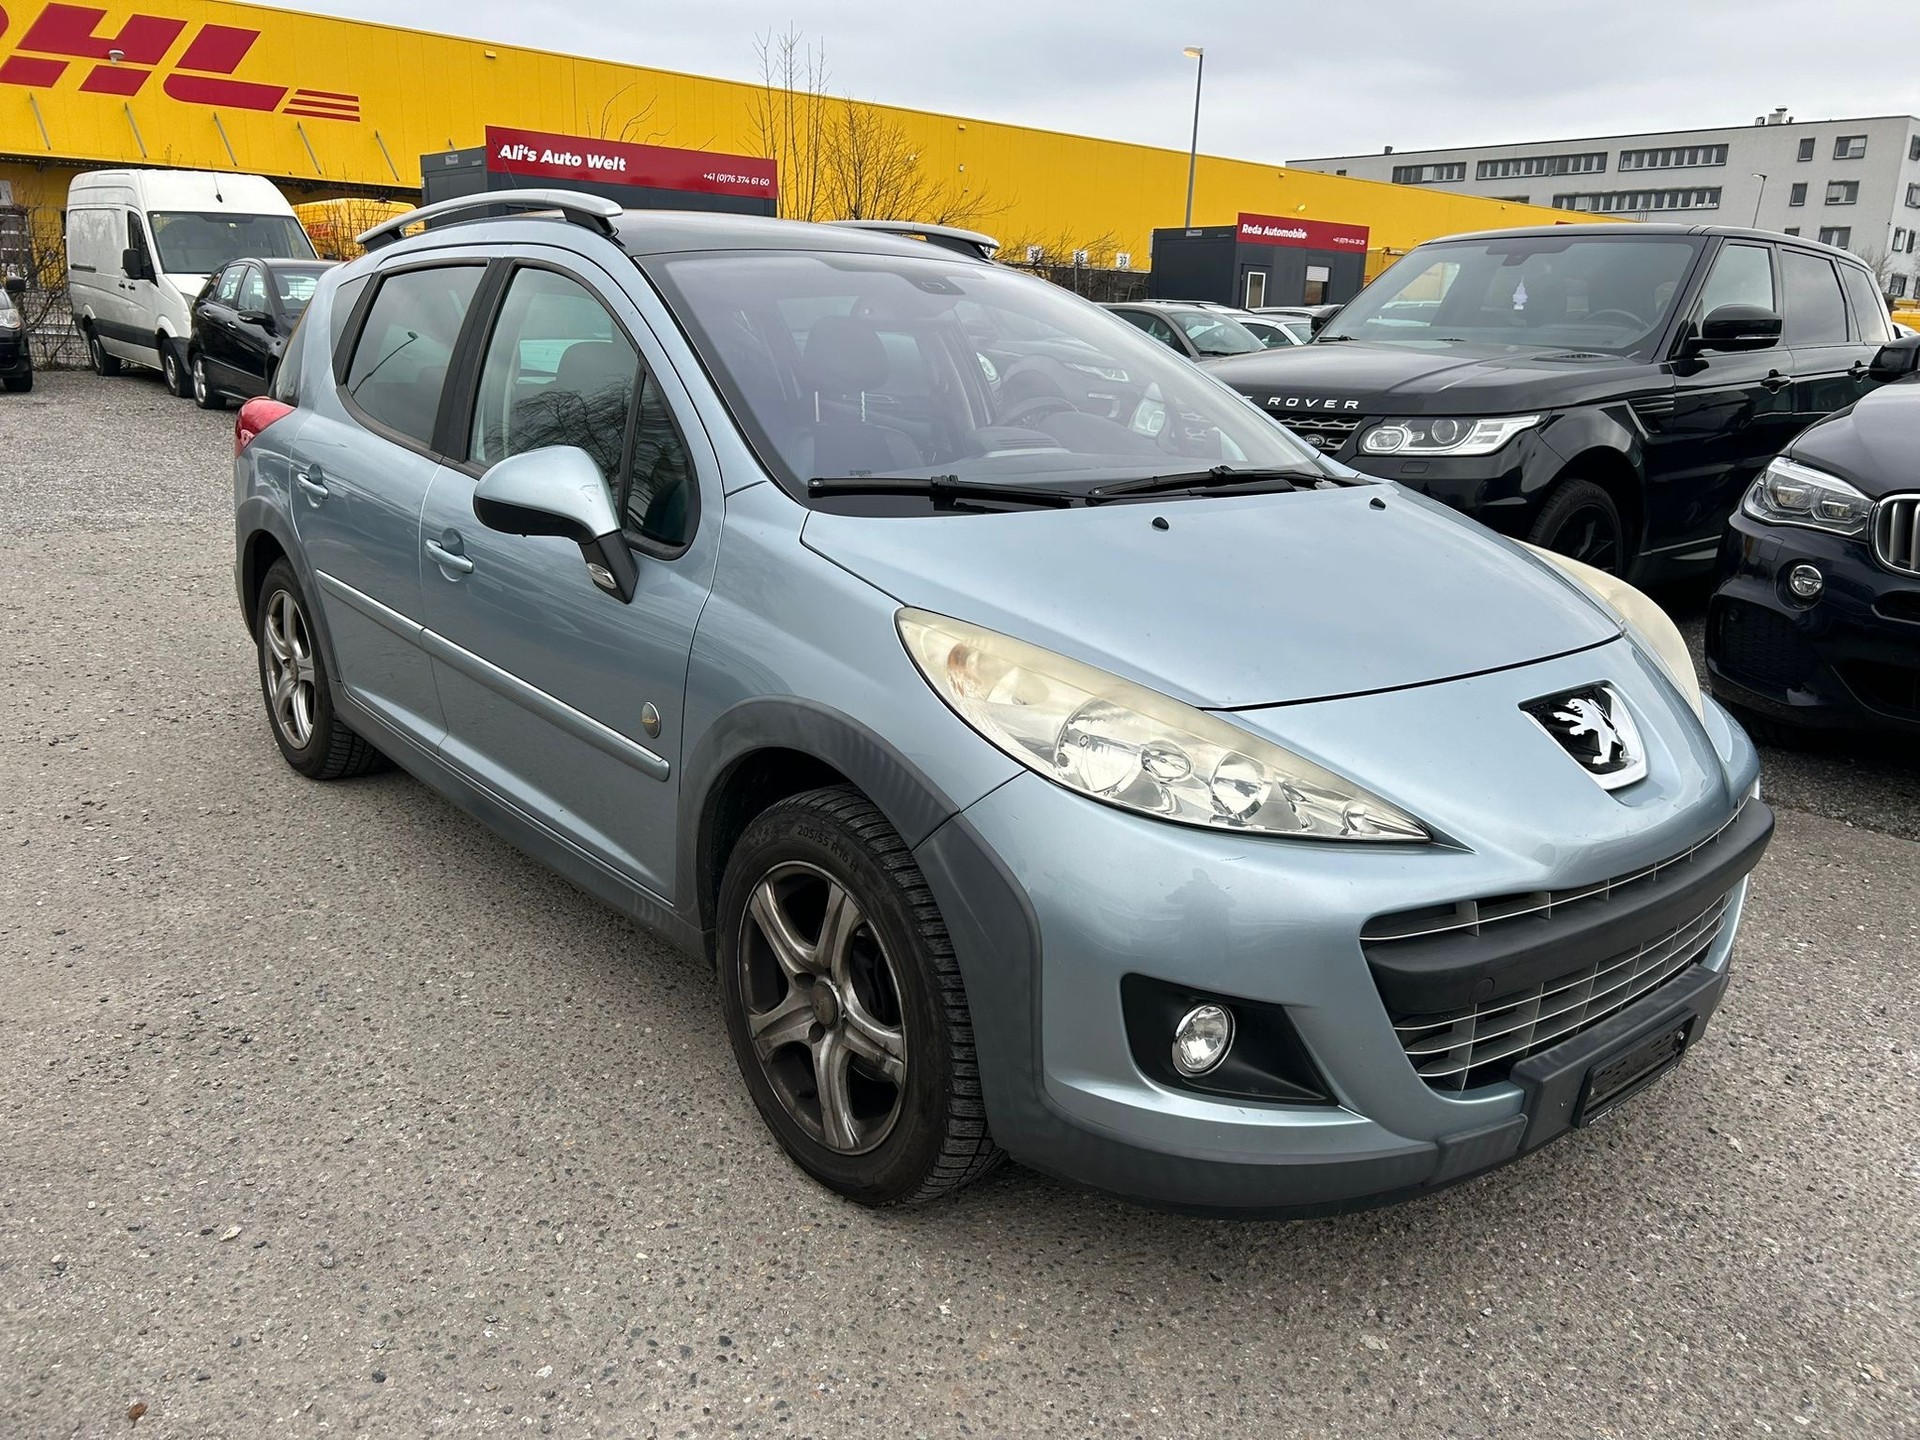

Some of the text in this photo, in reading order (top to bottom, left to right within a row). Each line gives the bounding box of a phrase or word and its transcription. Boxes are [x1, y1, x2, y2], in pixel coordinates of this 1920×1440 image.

[0, 2, 289, 112] HL
[498, 144, 626, 171] Ali's Auto Welt
[703, 173, 770, 186] +41 (0)76 374 61 60
[1242, 224, 1307, 239] Reda Automobile
[1268, 397, 1359, 409] ROVER
[797, 825, 829, 847] 205/55
